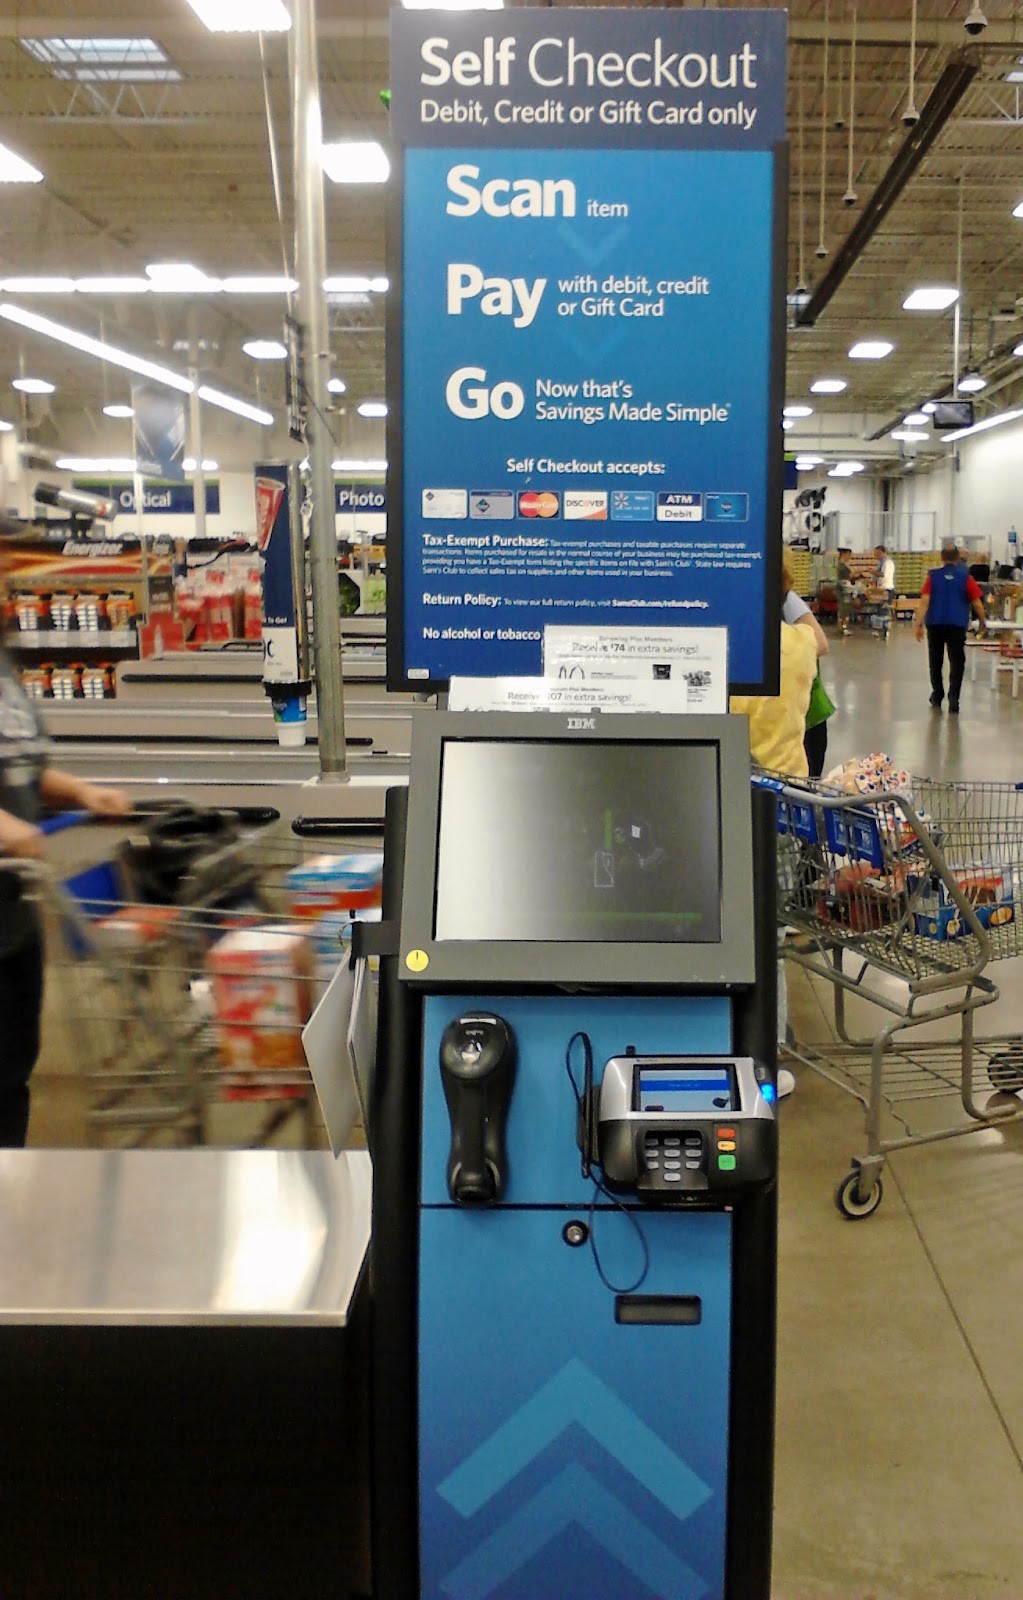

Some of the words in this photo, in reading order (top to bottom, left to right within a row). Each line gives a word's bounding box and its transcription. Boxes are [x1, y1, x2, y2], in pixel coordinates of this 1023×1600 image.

[421, 37, 515, 87] Self
[528, 37, 757, 89] Checkout
[421, 100, 488, 126] Debit,
[494, 100, 563, 124] Credit
[569, 106, 594, 124] or
[600, 100, 641, 125] Gift
[647, 100, 702, 125] Card
[708, 101, 757, 129] only
[446, 164, 576, 218] Scan
[587, 199, 628, 217] item
[447, 263, 547, 329] Pay
[558, 276, 597, 294] with
[602, 276, 653, 297] debit,
[657, 276, 709, 295] credit
[558, 301, 575, 316] or
[581, 298, 615, 317] Gift
[620, 299, 664, 317] Card
[446, 367, 525, 420] Go
[536, 380, 579, 397] Now
[583, 379, 633, 398] that's
[536, 403, 605, 424] Savings
[609, 403, 662, 421] Made
[506, 459, 534, 473] Self
[537, 459, 604, 473] Checkout
[607, 461, 666, 476] accepts:
[340, 490, 385, 507] Photo
[666, 495, 693, 504] ATM
[664, 510, 692, 518] Debit
[422, 533, 491, 548] Tax-Exempt
[492, 534, 549, 547] Purchase:
[422, 592, 462, 605] Return
[464, 593, 501, 607] Policy:
[423, 626, 440, 639] No
[441, 627, 481, 639] alcohol
[482, 629, 495, 639] or
[497, 628, 541, 640] tobacco
[638, 645, 660, 653] extra
[567, 717, 596, 729] IBM
